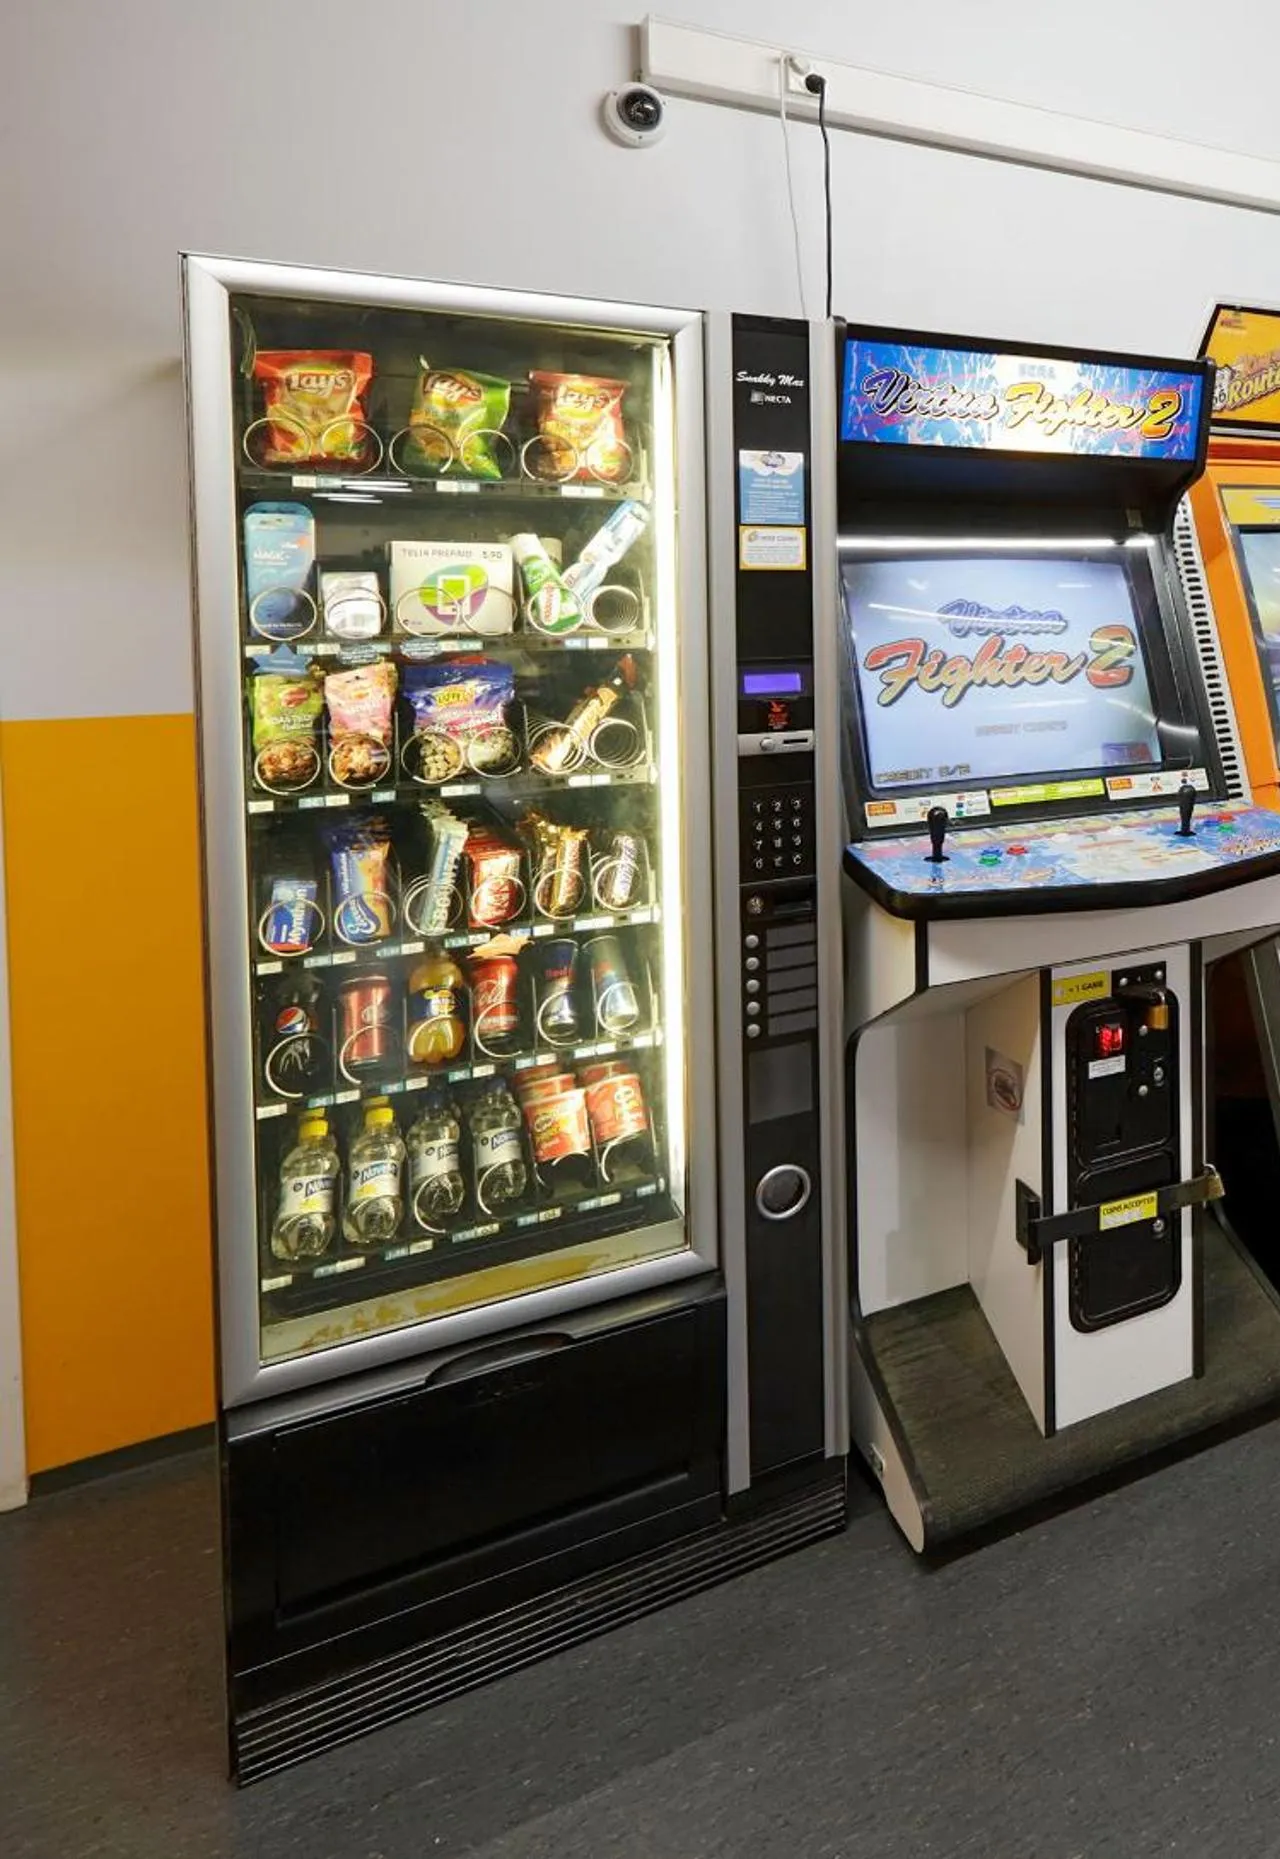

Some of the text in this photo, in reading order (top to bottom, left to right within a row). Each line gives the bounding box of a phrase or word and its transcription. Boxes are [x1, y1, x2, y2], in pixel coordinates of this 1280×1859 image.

[863, 367, 999, 421] Virtua
[1140, 390, 1183, 440] 2
[864, 624, 1136, 708] Fighter 2
